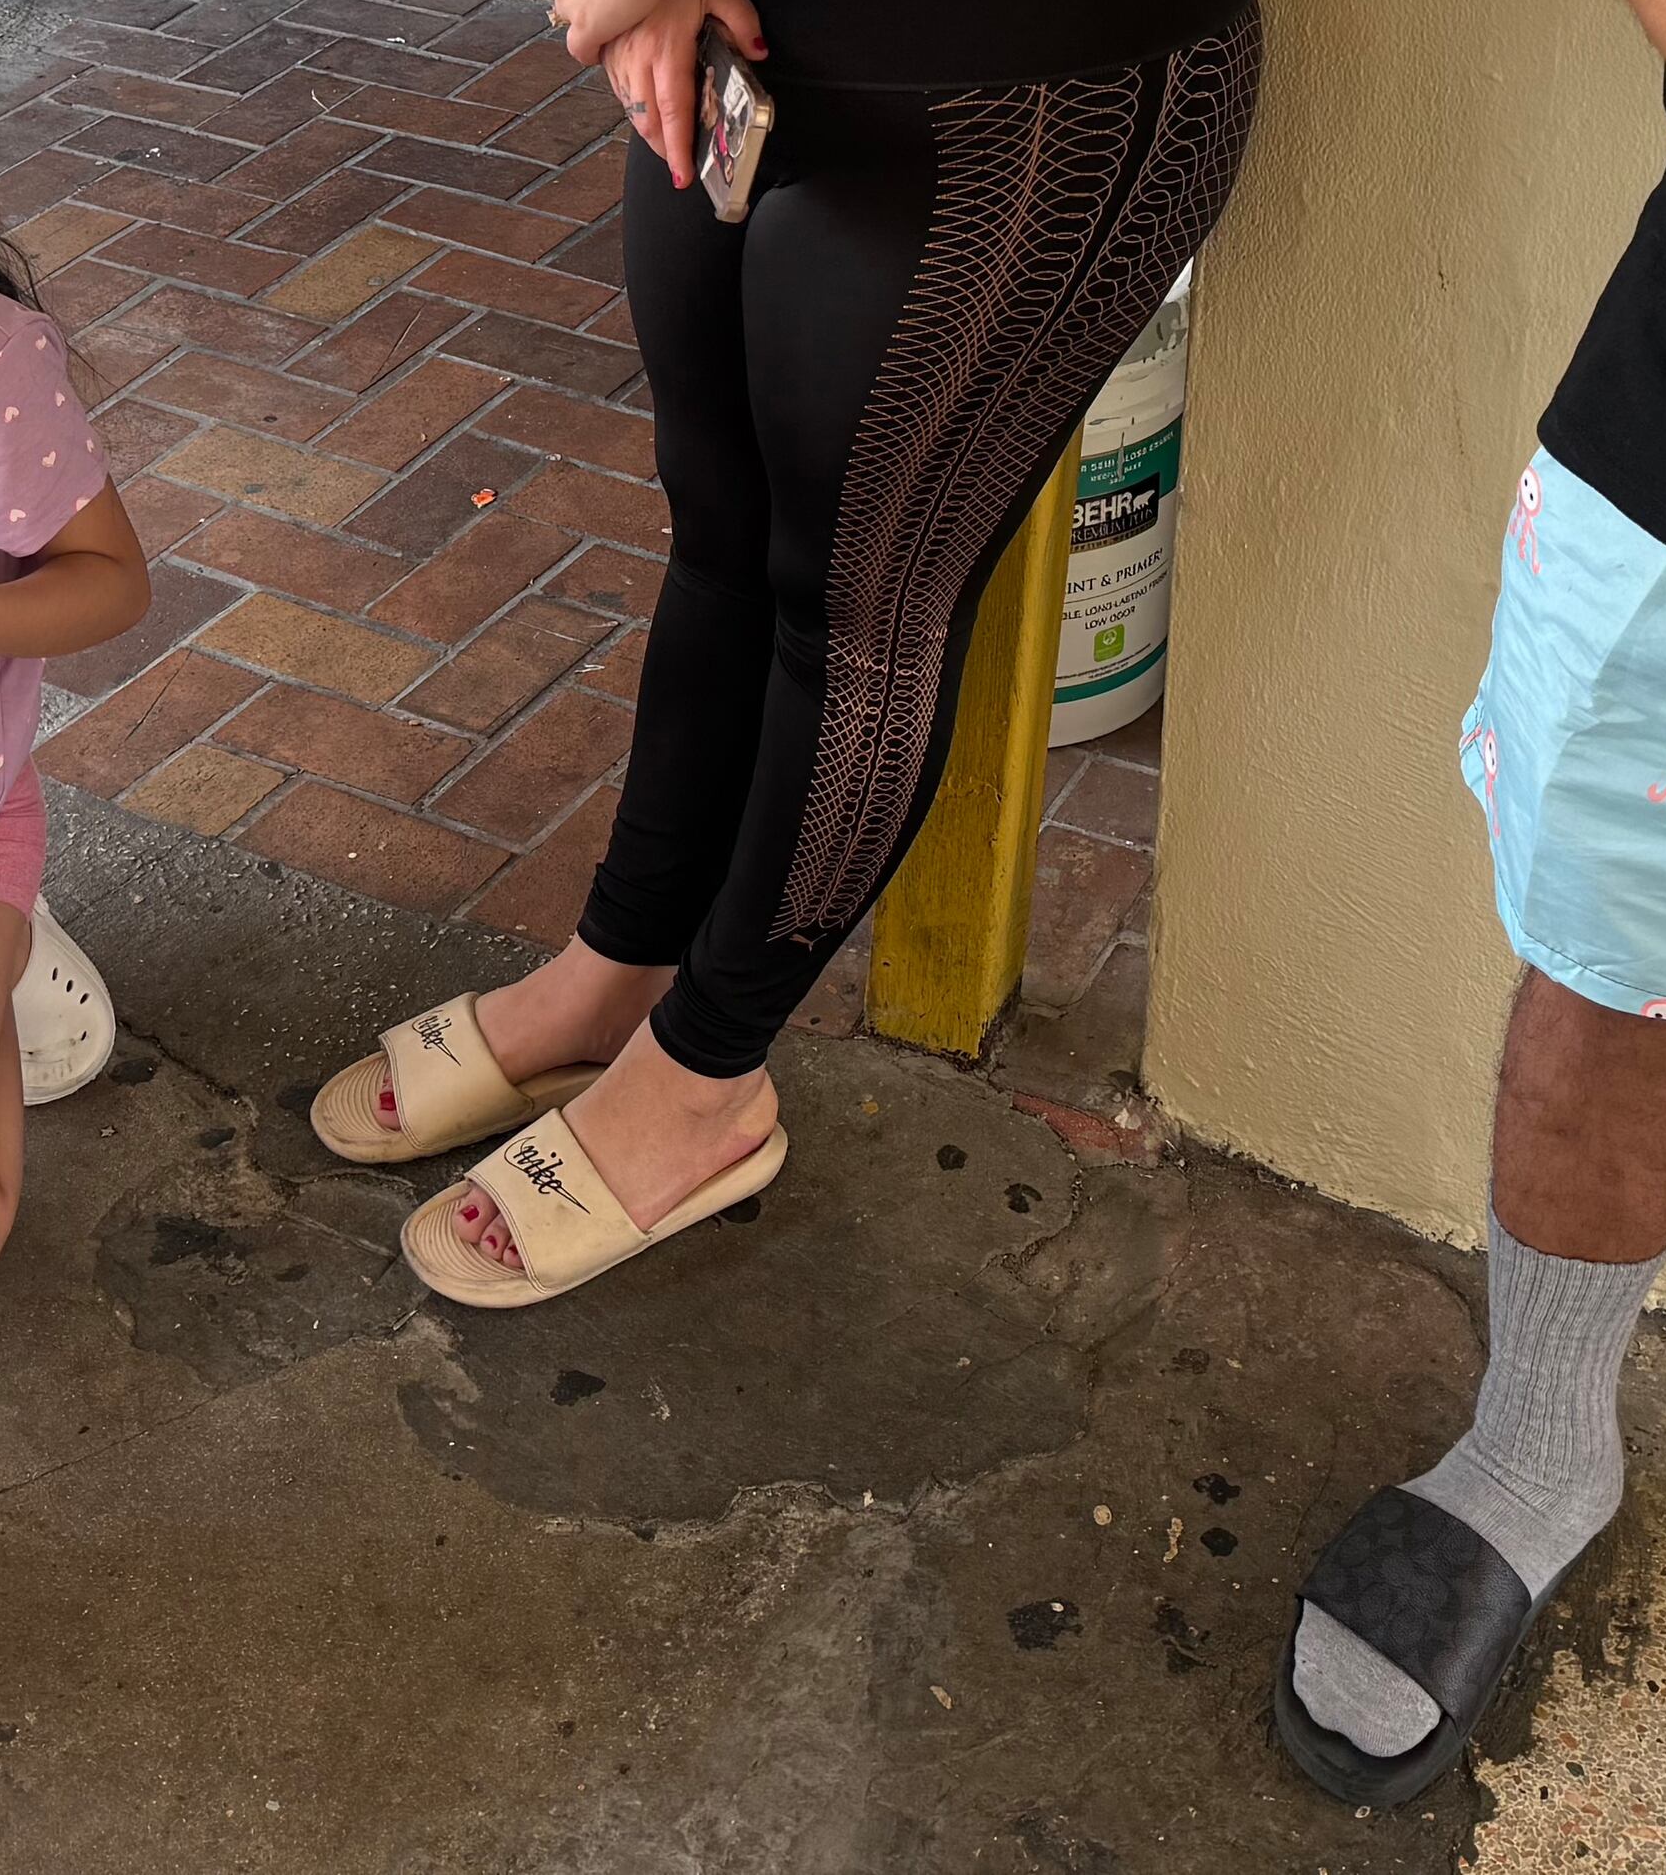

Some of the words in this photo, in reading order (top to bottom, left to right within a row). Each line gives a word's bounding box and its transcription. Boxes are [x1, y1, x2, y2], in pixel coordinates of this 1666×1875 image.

[1072, 491, 1133, 529] BEHR
[1065, 577, 1097, 595] INT
[1100, 574, 1111, 587] &
[1085, 617, 1107, 630] LOW
